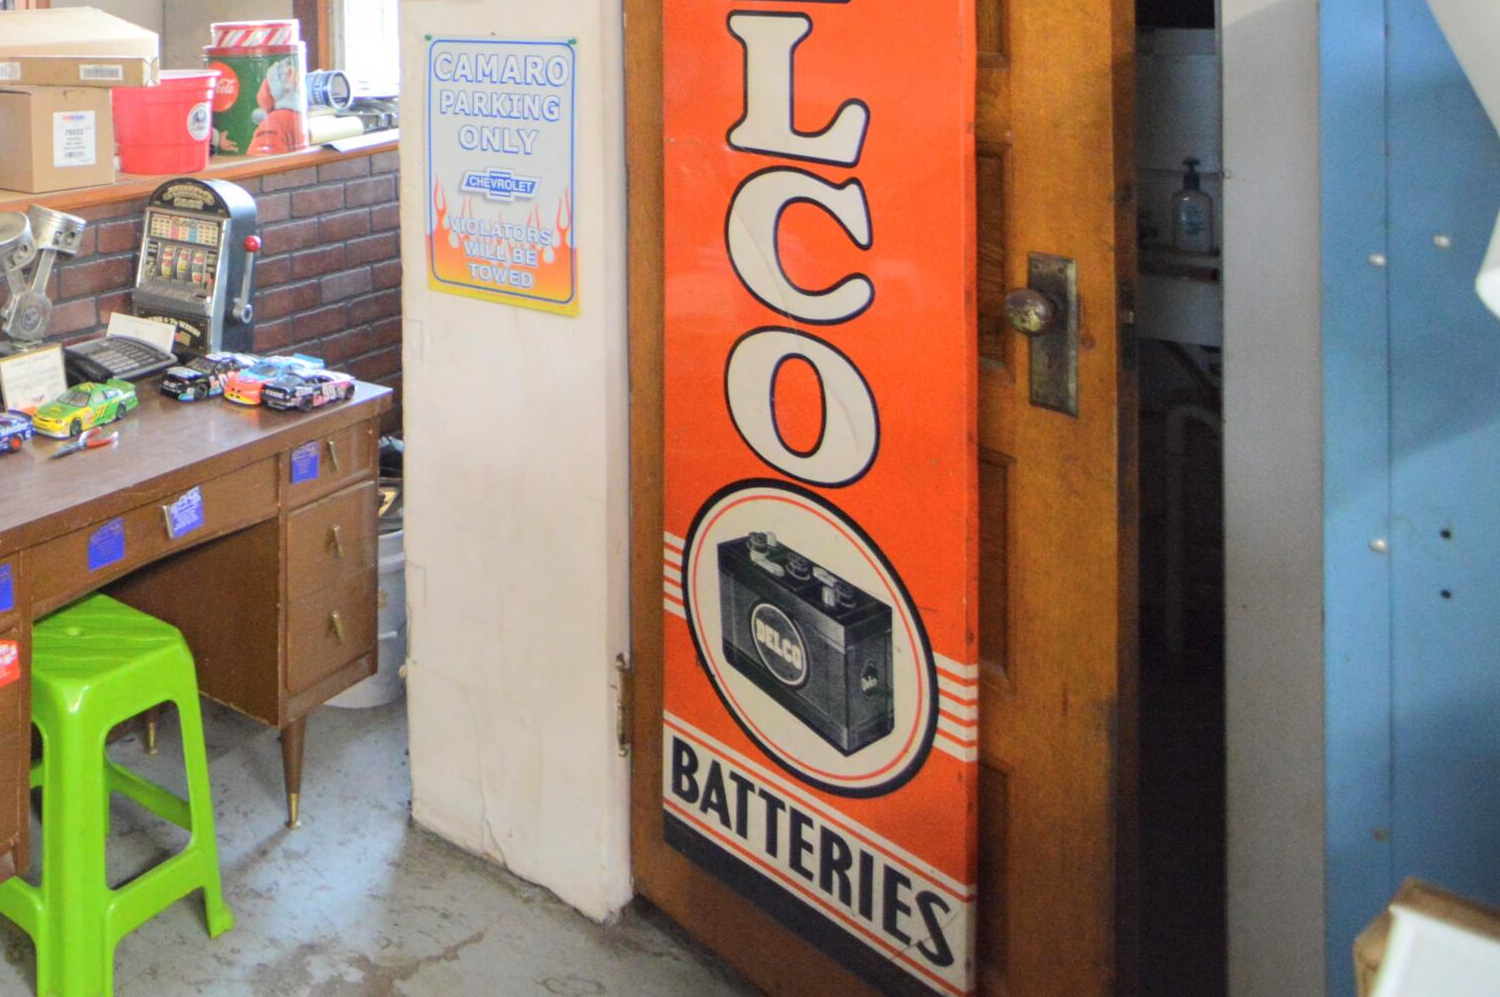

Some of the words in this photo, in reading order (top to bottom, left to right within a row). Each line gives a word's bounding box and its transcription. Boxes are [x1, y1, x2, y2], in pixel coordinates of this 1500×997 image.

[434, 52, 569, 87] CAMARO
[440, 90, 561, 121] PARKING
[459, 125, 539, 154] ONLY
[469, 175, 532, 193] CHEVROLET
[450, 216, 552, 246] VIOLATORS
[464, 241, 508, 261] WILL
[513, 247, 537, 266] BE
[468, 262, 535, 287] TOWED
[756, 618, 802, 670] DELCO
[672, 735, 955, 969] BATTERIES
